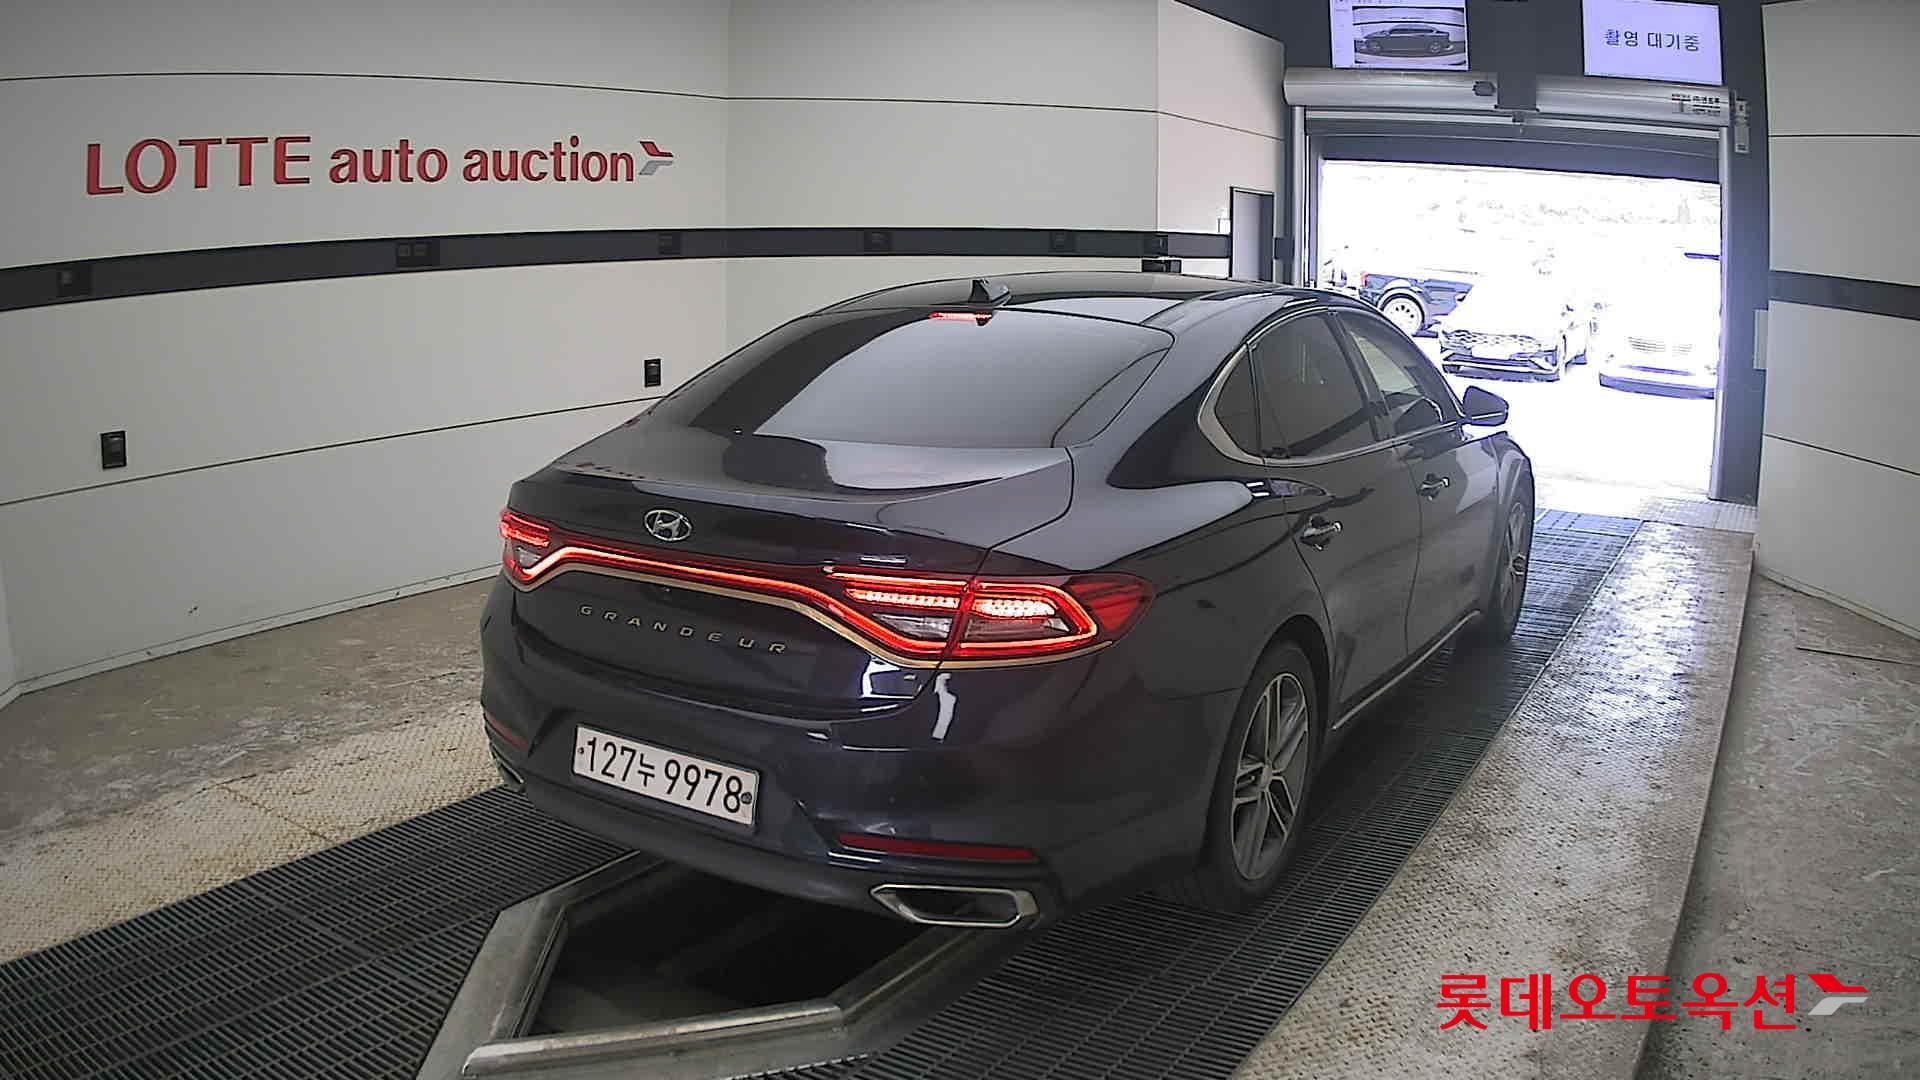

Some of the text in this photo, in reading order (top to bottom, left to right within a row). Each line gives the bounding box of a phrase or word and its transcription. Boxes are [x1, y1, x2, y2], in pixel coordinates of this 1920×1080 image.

[1604, 28, 1699, 52] 촬영 대기중
[86, 135, 635, 195] LOTTE auto auction
[579, 605, 787, 653] GRANDEUR
[587, 736, 743, 814] 127누 9978
